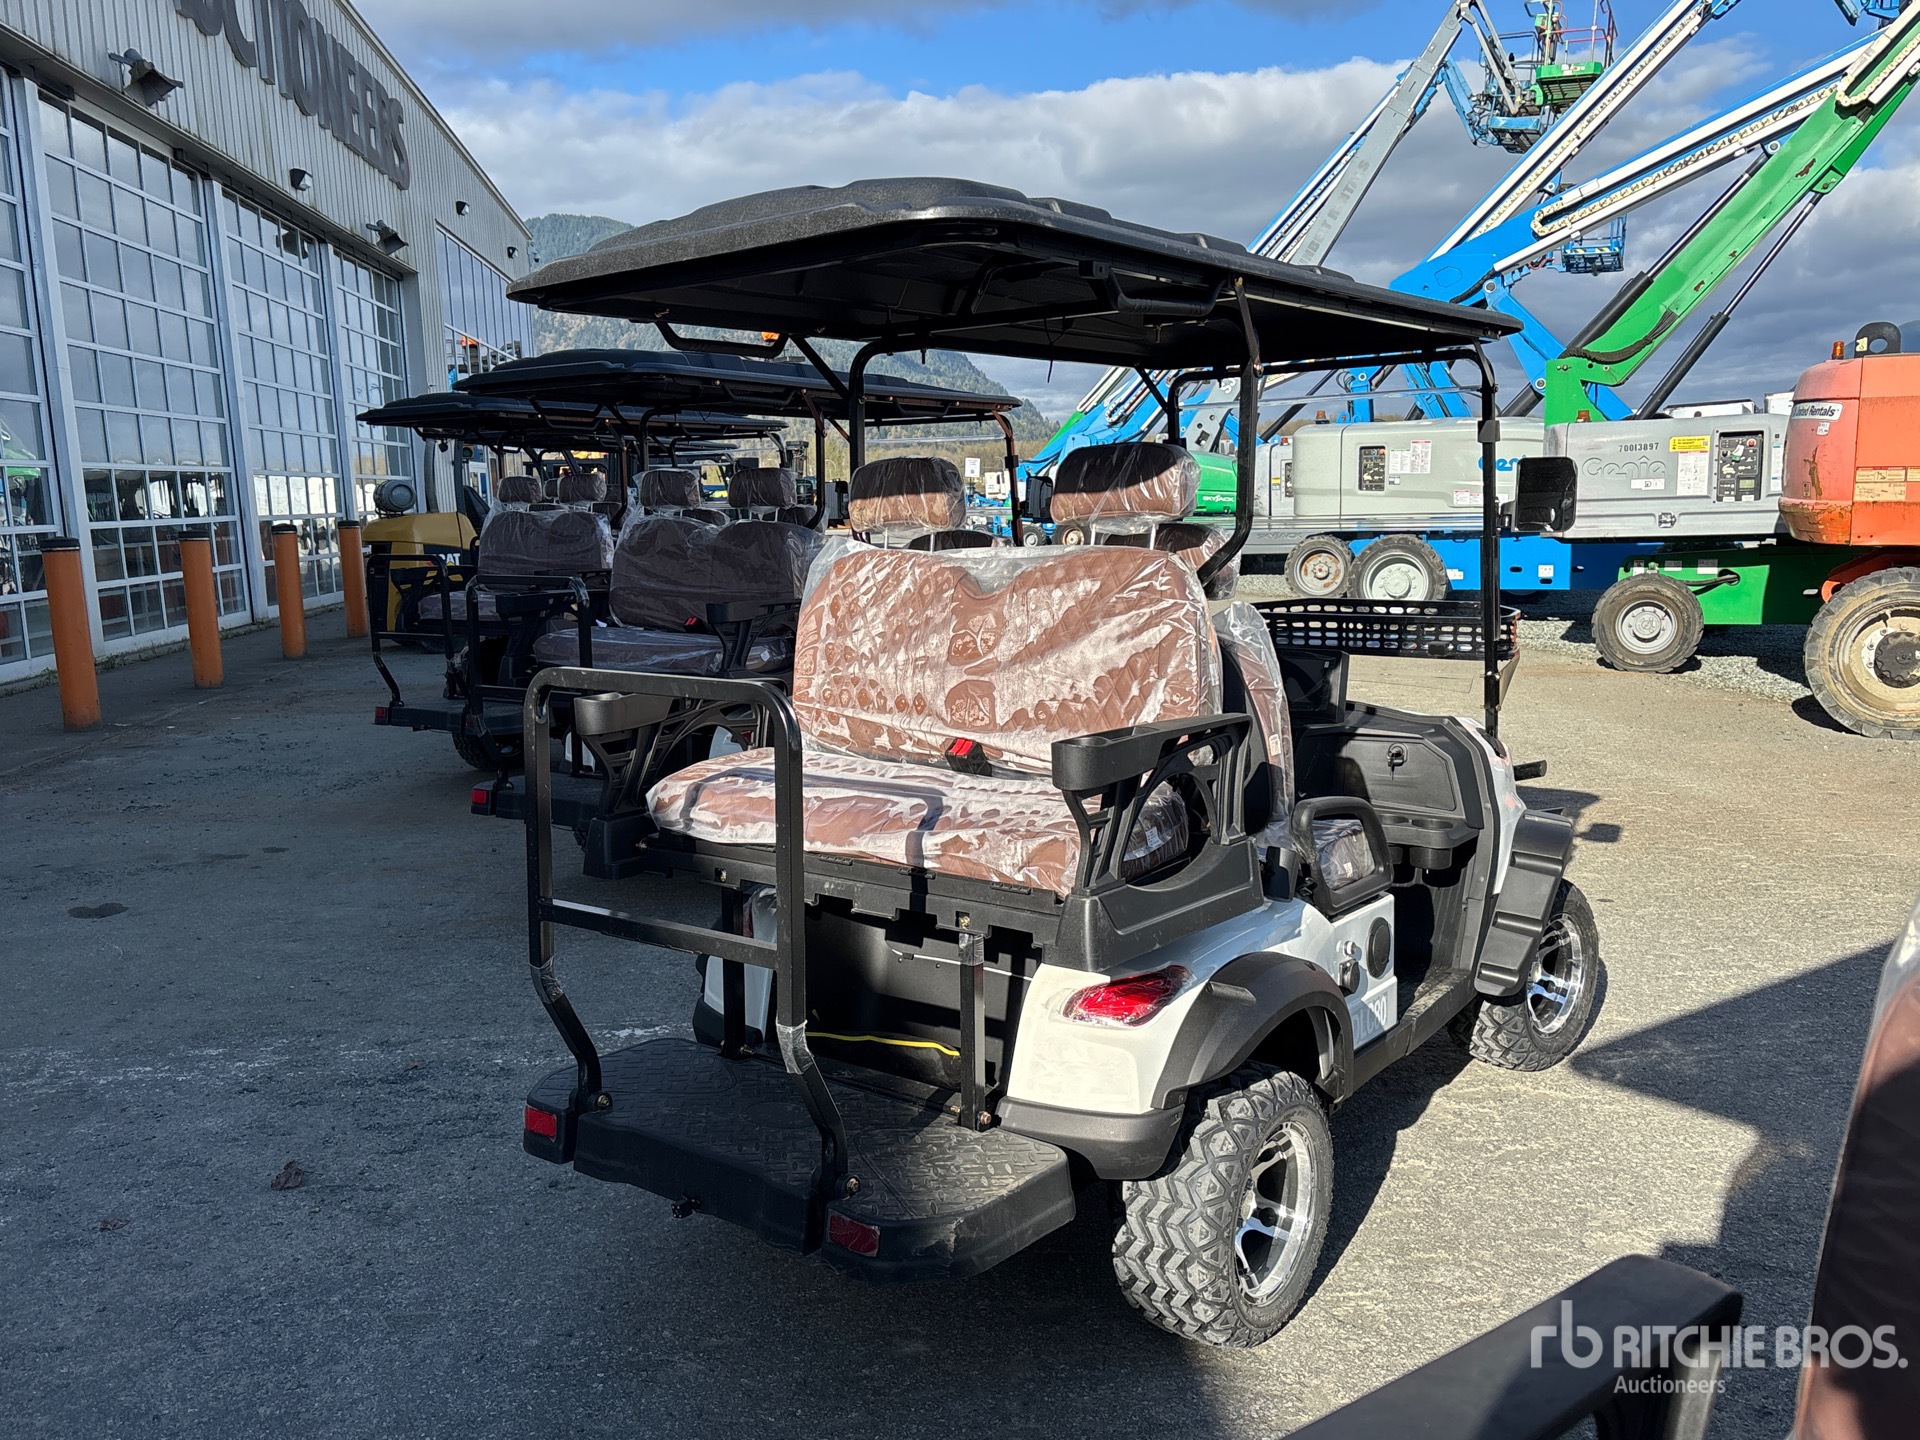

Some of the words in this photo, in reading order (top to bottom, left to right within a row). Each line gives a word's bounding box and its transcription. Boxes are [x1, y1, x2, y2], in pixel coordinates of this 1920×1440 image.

[1809, 405, 1836, 417] Rentals
[1618, 442, 1660, 453] 70013897
[1582, 455, 1667, 481] Genie
